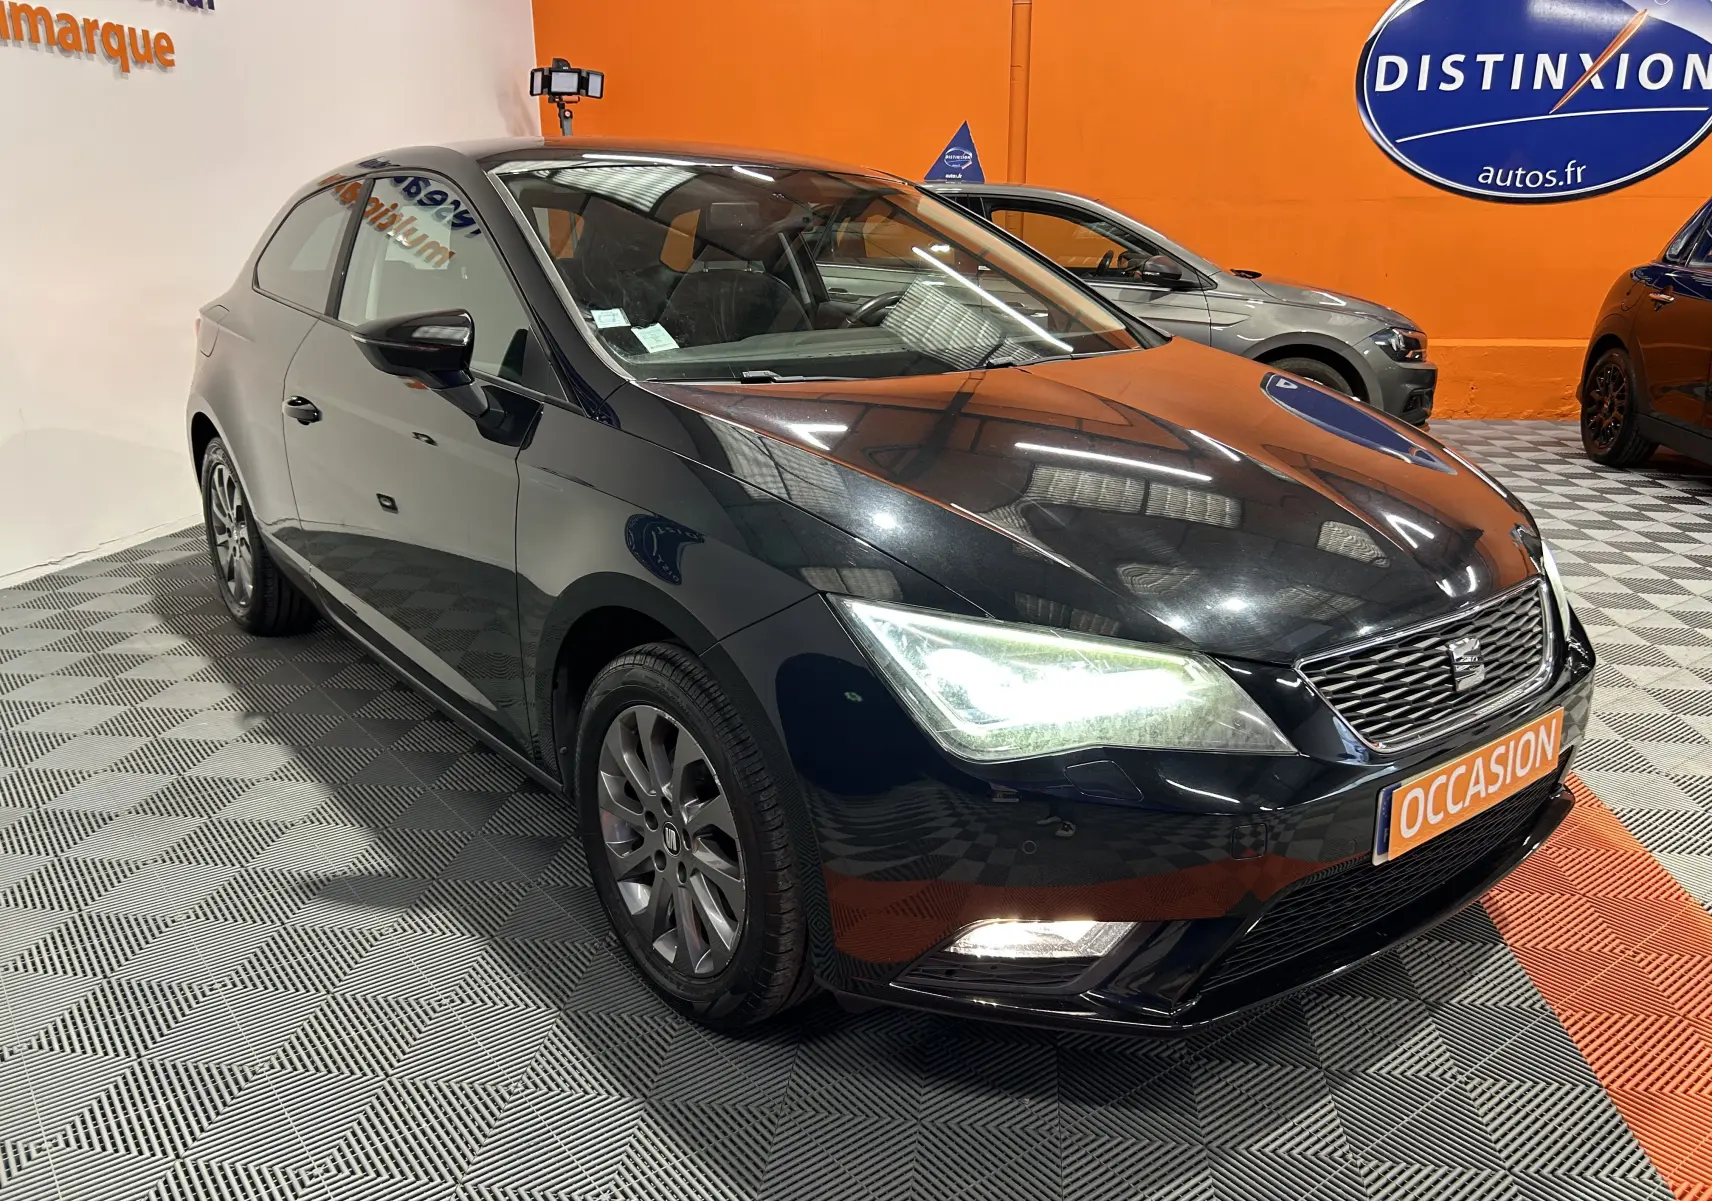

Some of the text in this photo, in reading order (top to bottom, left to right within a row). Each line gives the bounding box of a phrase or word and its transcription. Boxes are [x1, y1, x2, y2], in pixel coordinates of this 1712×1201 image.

[1374, 53, 1712, 92] DISTINXION
[1477, 160, 1587, 188] autos.fr
[1400, 719, 1557, 839] OCCASION
